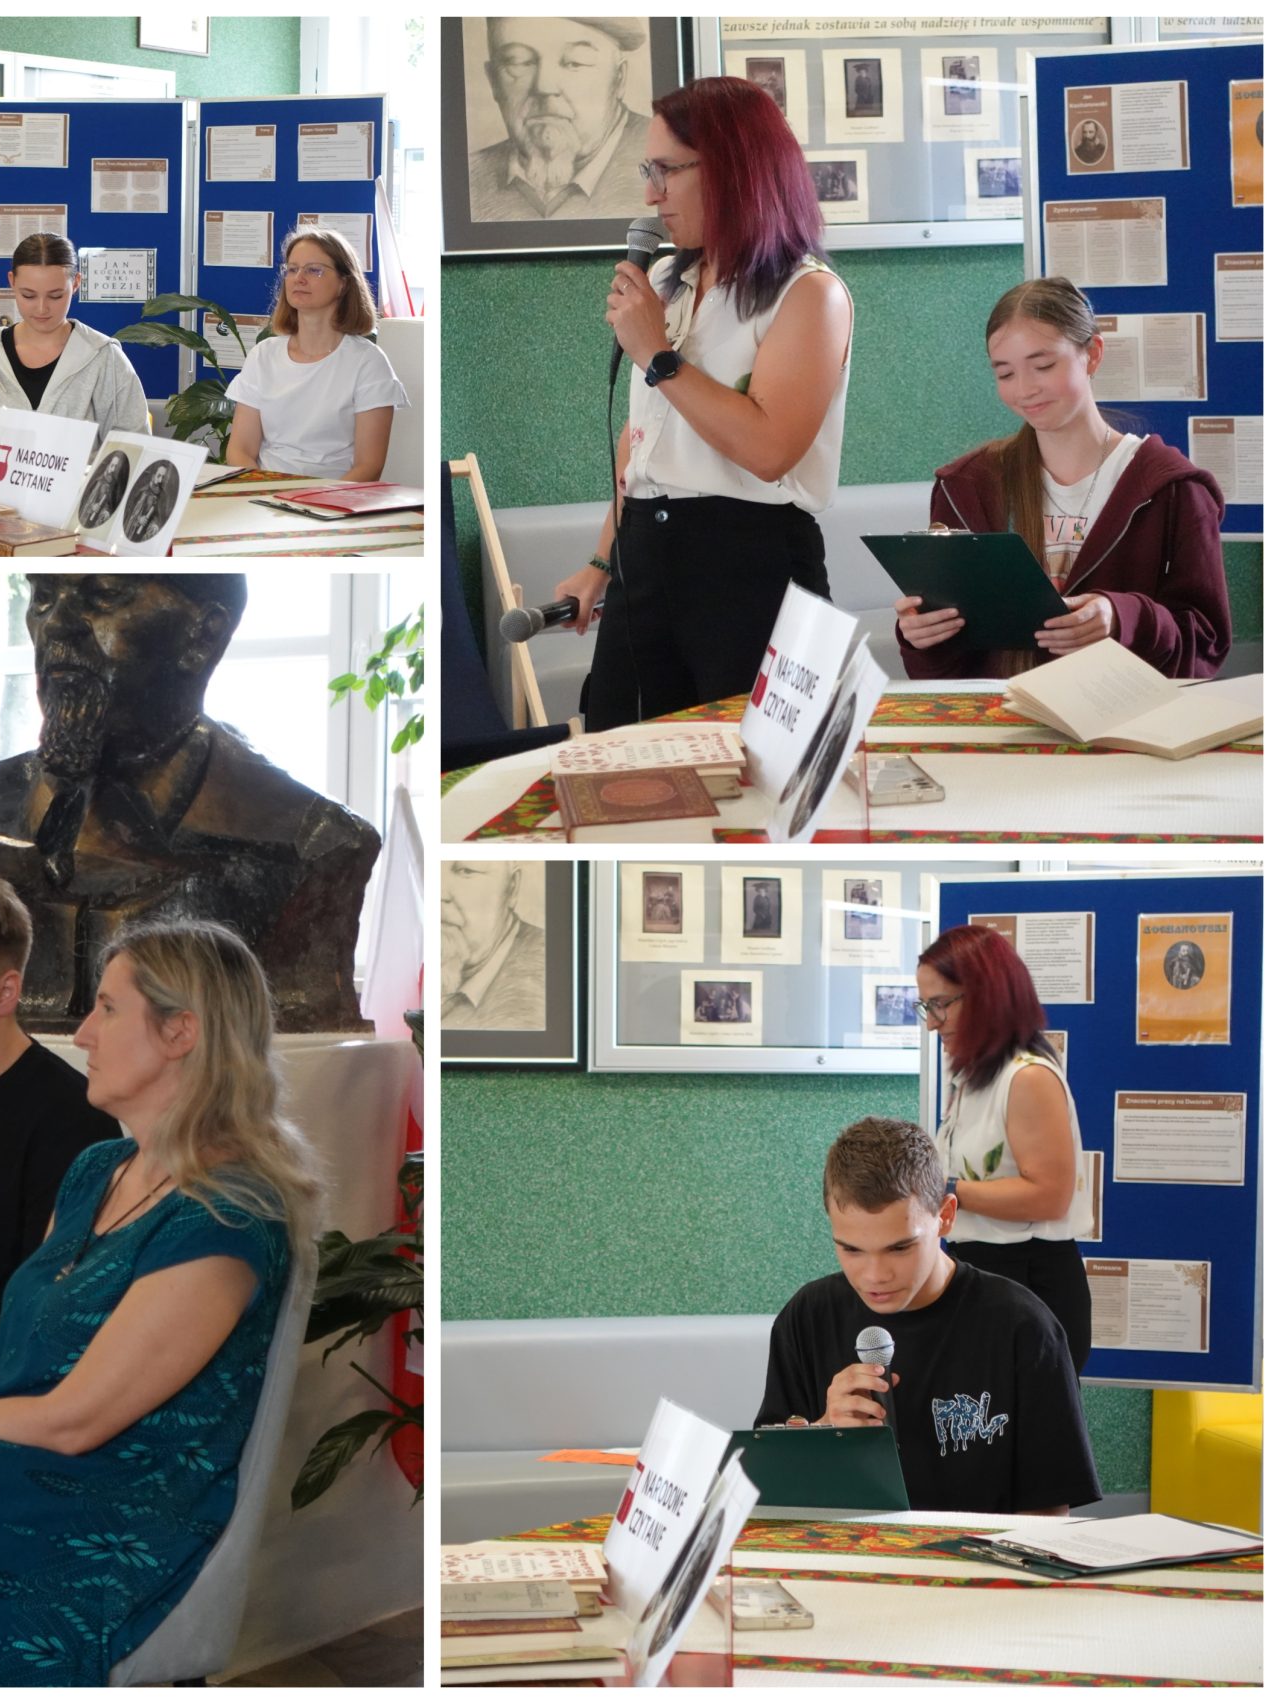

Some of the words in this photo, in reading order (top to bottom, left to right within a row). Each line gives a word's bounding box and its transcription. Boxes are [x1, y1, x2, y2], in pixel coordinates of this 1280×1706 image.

[724, 20, 768, 32] zawsze
[770, 18, 810, 34] jednak
[815, 19, 870, 31] zostawia
[874, 20, 887, 30] za
[890, 18, 916, 30] sobą
[920, 17, 970, 30] nadzieję
[104, 261, 129, 270] JAN
[15, 448, 70, 472] NARODOWE
[9, 470, 54, 493] CZYTANIE
[774, 654, 820, 700] NARODOWE
[764, 691, 800, 733] CZYTANIE
[641, 1470, 688, 1518] NARODOWE
[628, 1507, 667, 1552] CZYTANIE
